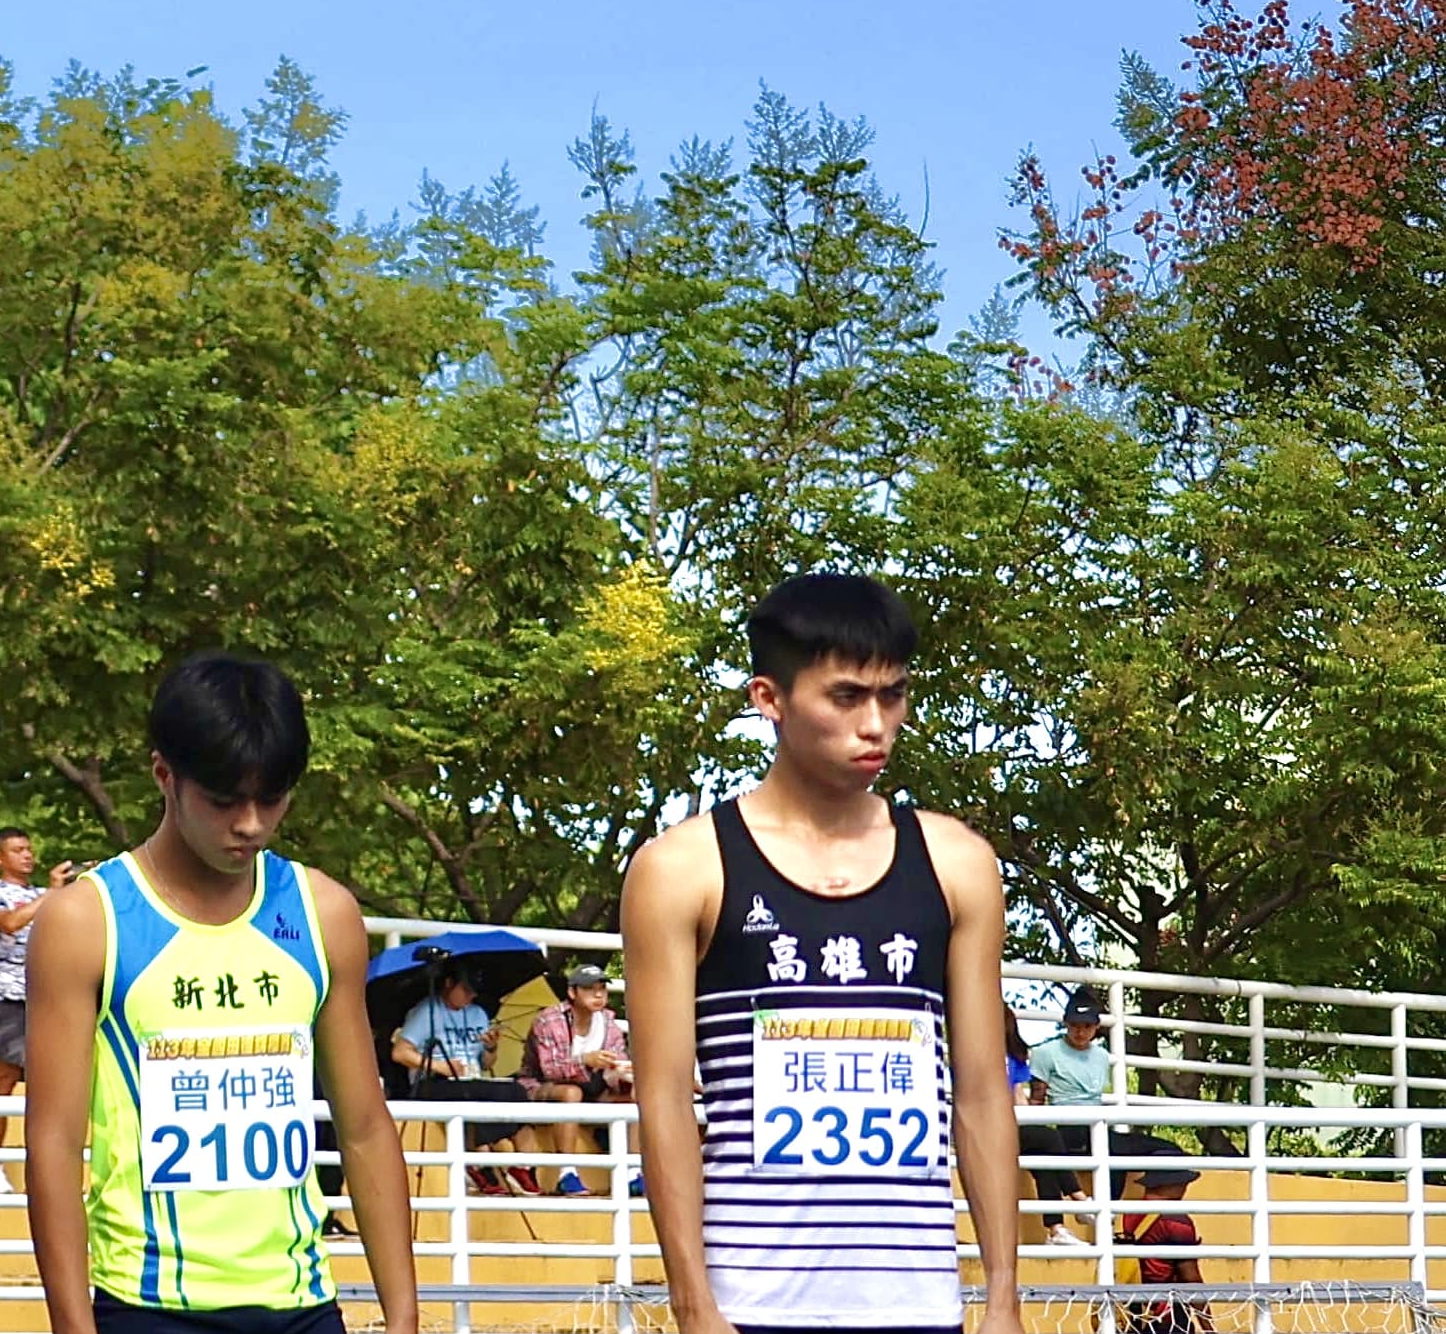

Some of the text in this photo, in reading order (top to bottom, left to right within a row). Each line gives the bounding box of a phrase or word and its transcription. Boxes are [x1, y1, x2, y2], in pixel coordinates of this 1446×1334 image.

[767, 933, 918, 984] 高雄市
[172, 970, 280, 1010] 新北市
[171, 1065, 296, 1112] 曾仲強
[783, 1051, 914, 1095] 張正偉
[151, 1119, 308, 1183] 2100
[762, 1105, 929, 1167] 2352
